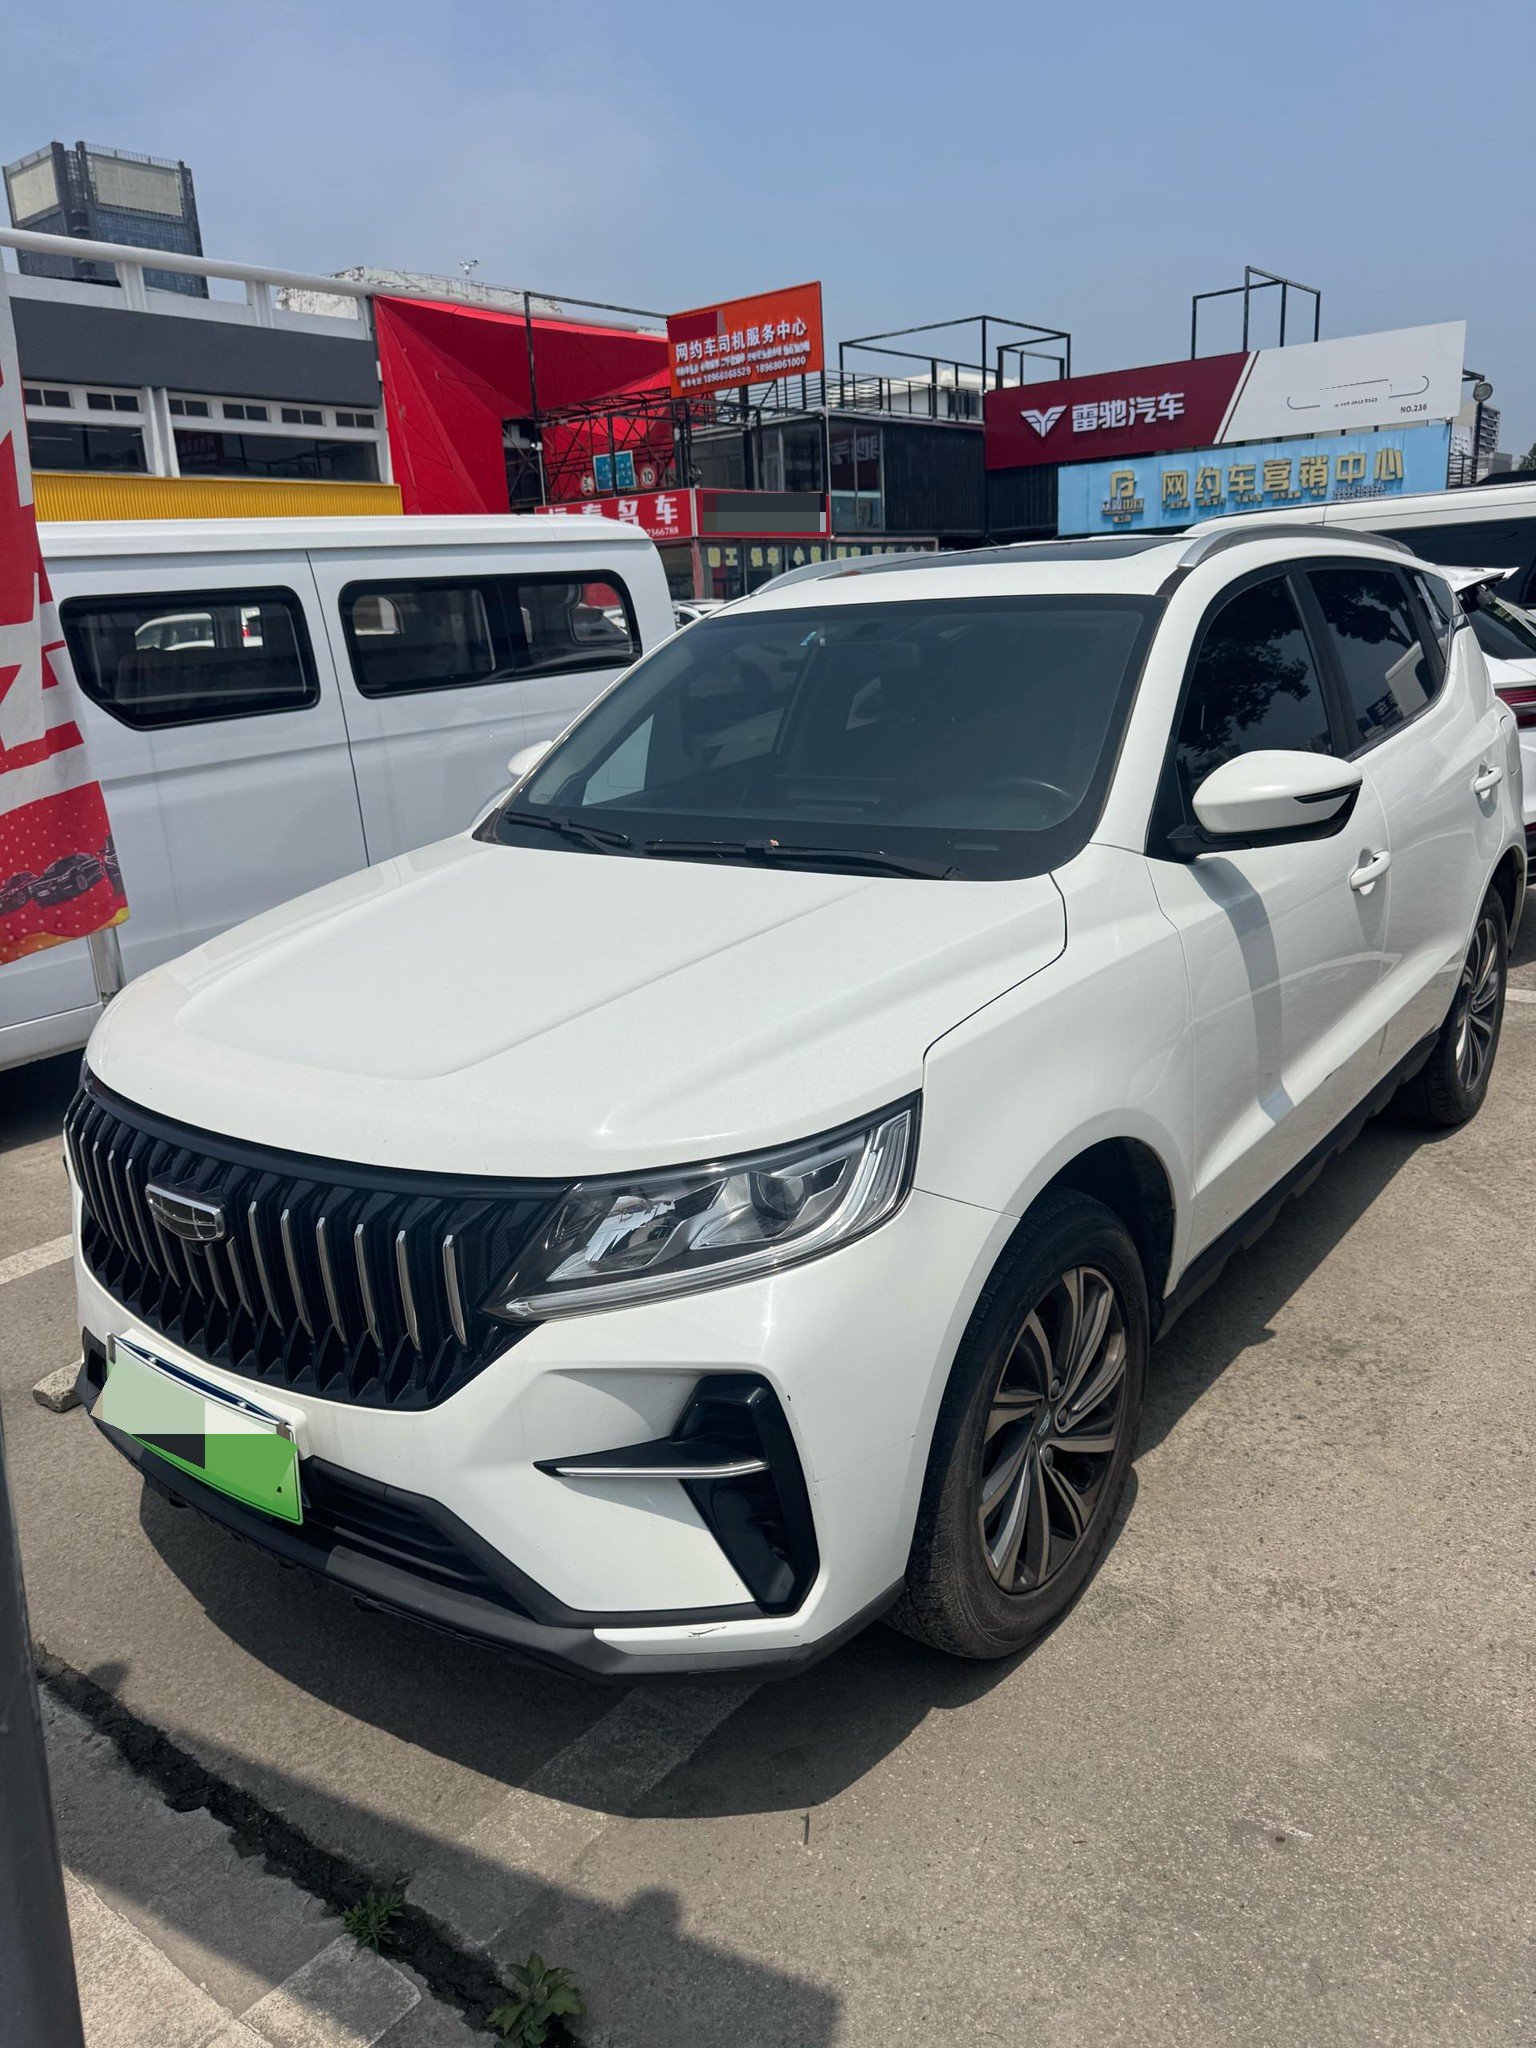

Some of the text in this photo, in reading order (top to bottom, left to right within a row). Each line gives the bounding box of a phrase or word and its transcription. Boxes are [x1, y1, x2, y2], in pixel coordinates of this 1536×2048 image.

[676, 317, 807, 362] 网约车司机服务中心
[1072, 393, 1184, 433] 雷驰汽车
[1162, 449, 1404, 502] 网约车营销中心
